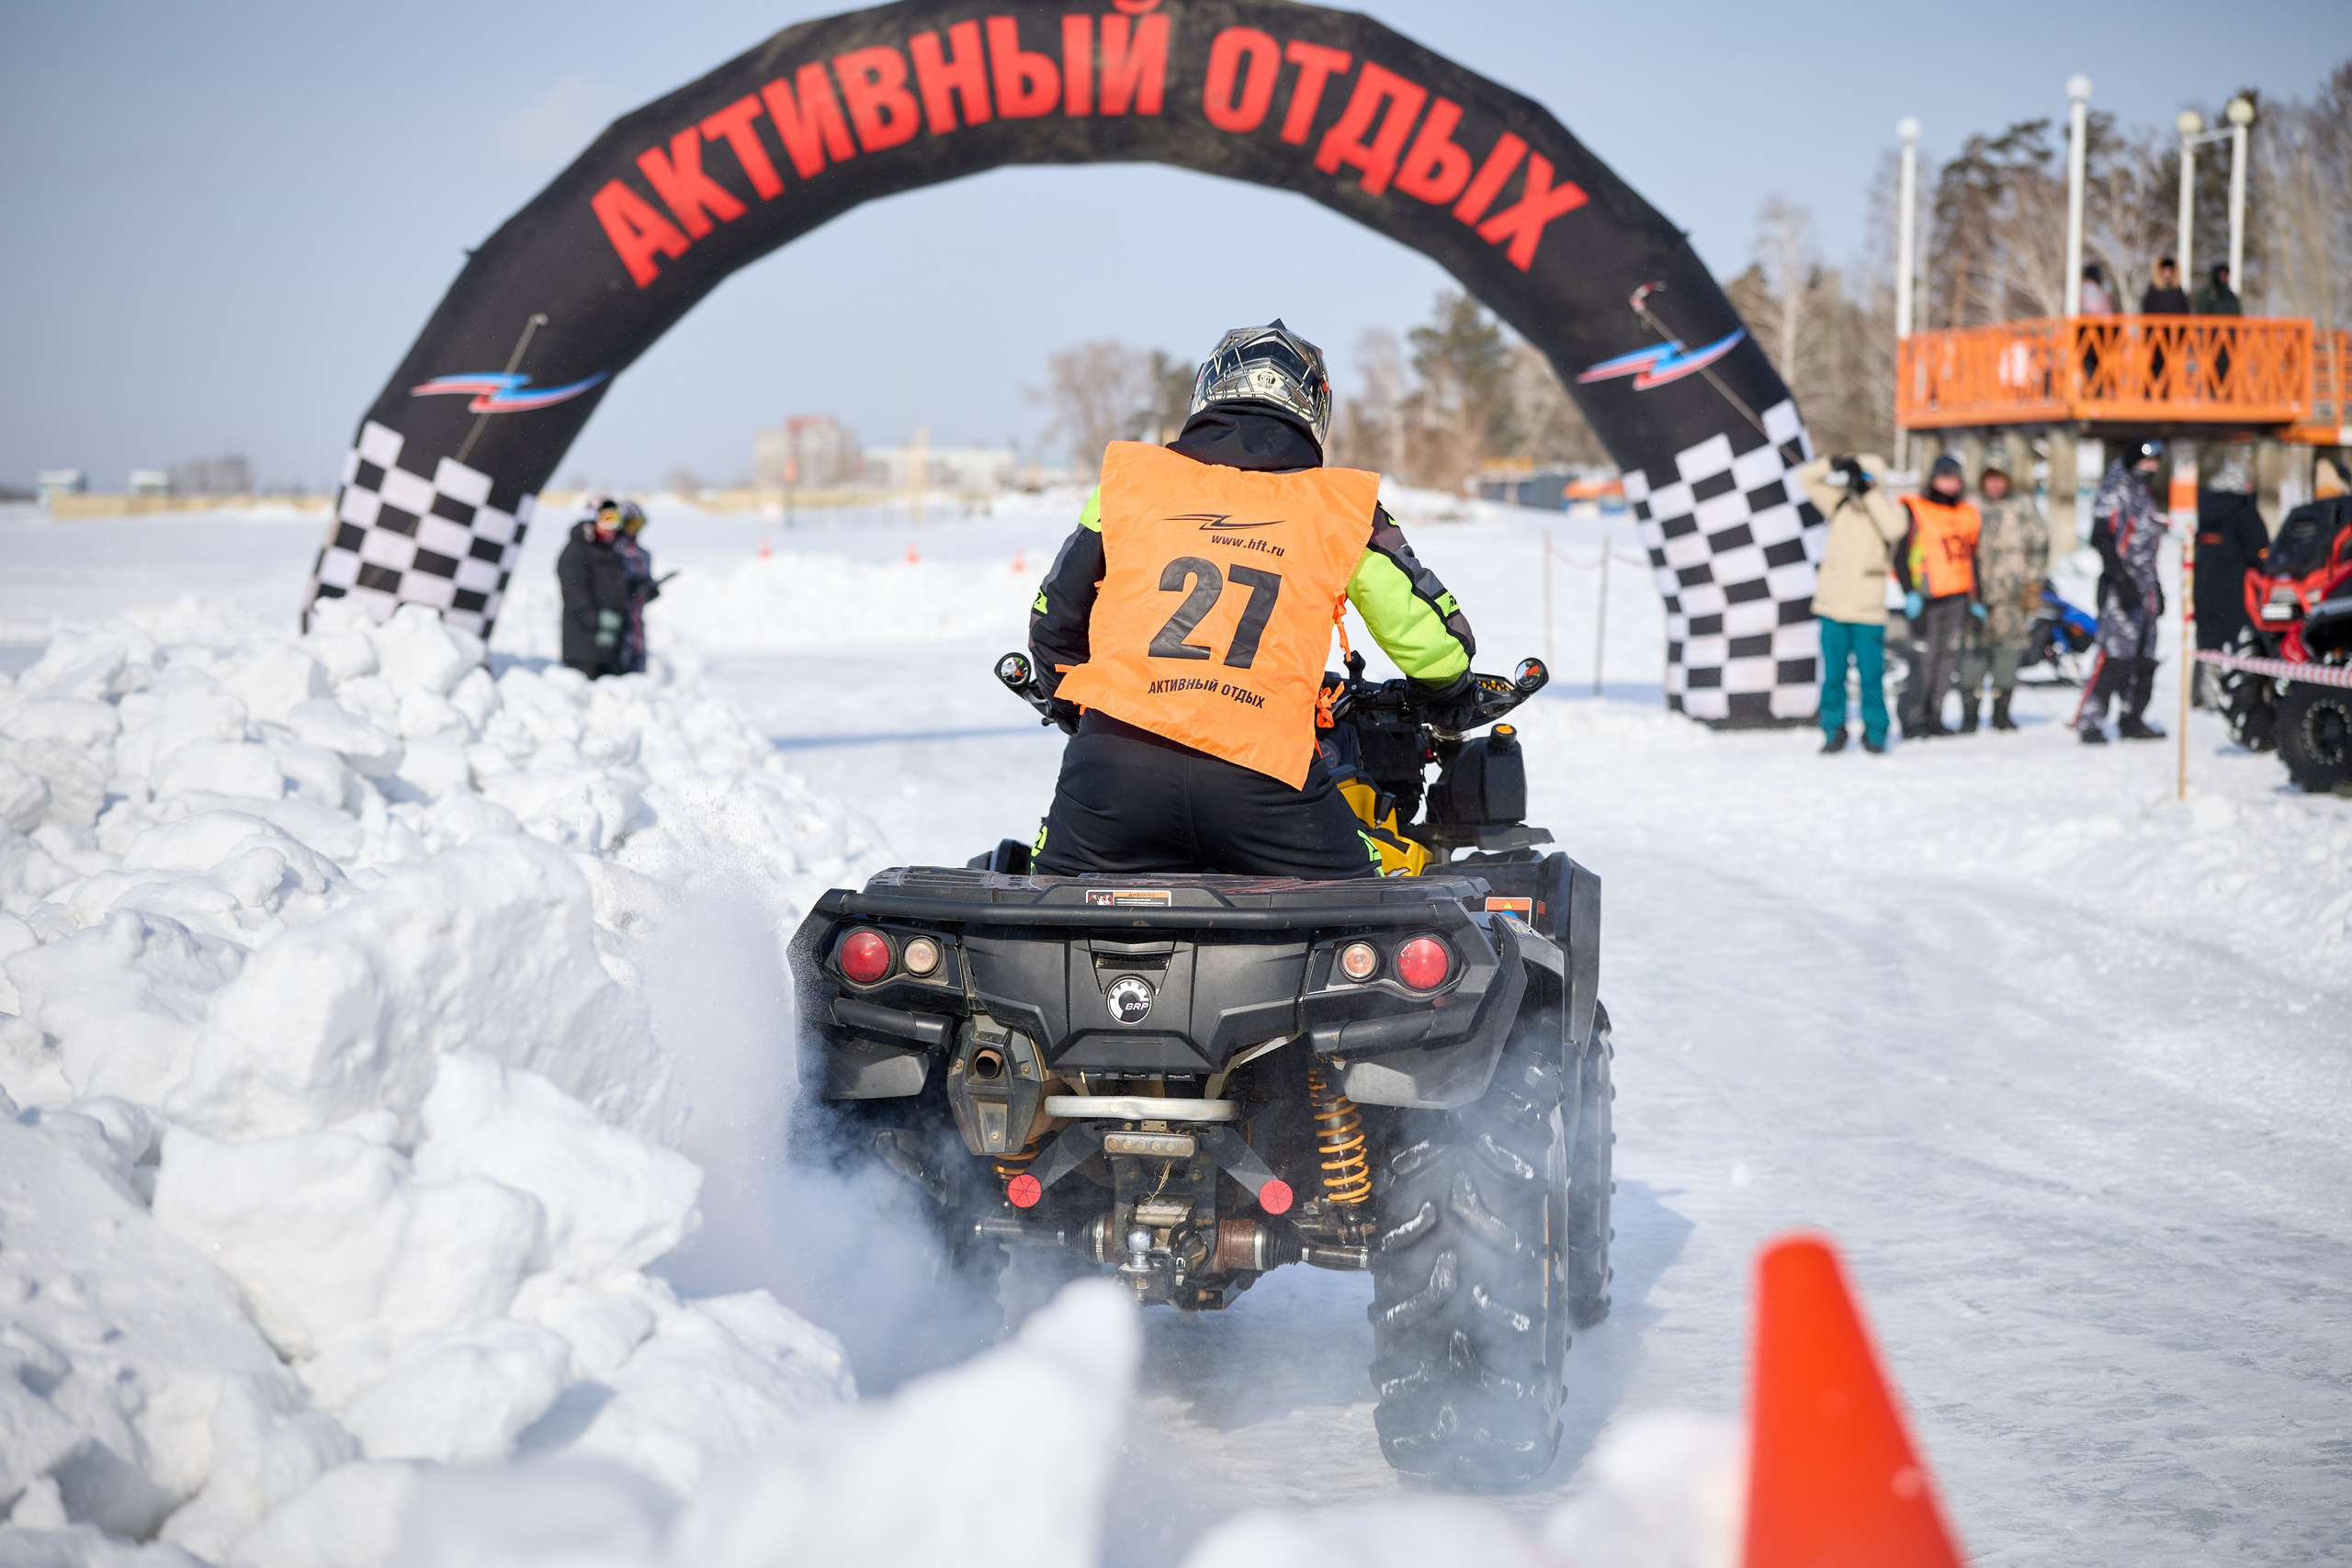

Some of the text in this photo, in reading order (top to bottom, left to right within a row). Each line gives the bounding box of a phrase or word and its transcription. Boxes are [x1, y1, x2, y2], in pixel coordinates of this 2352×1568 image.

[591, 0, 1589, 288] АКТИВНЫЙ ОТДЫХ
[1211, 535, 1285, 557] www.hft.ru
[1148, 556, 1283, 670] 27
[1148, 677, 1266, 708] АКТИВНЫЙ ОТДЫХ
[1125, 1002, 1149, 1010] BRP
